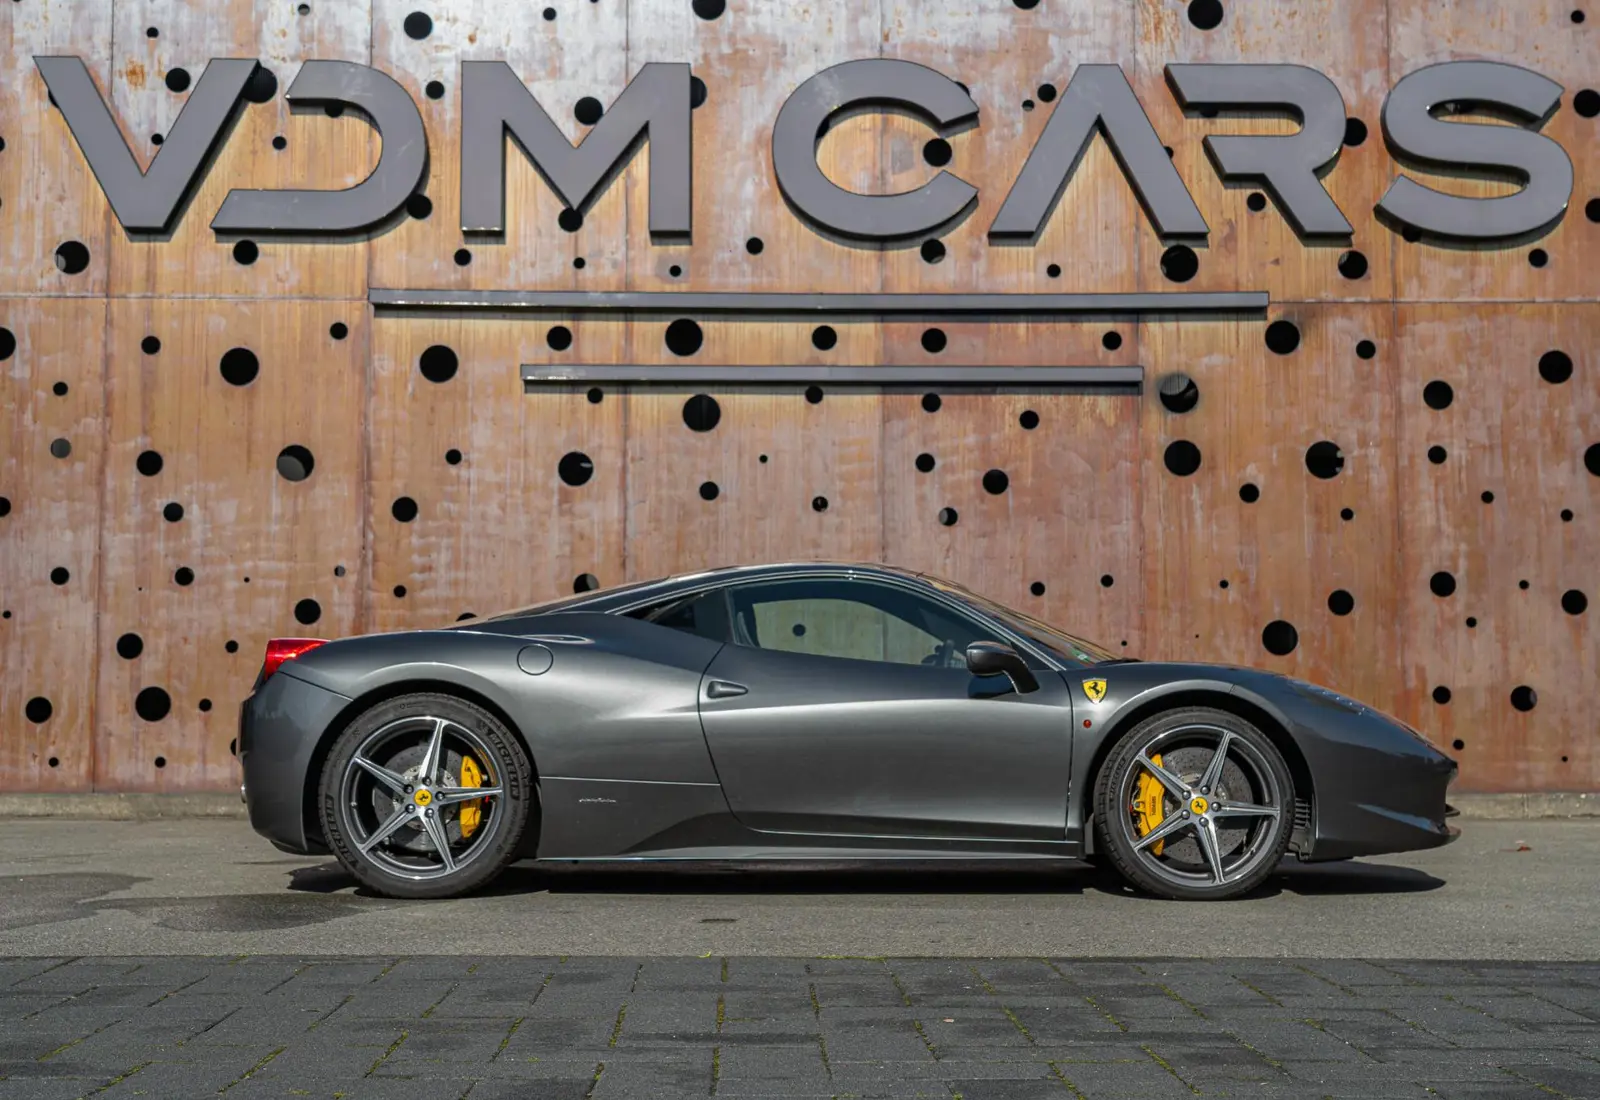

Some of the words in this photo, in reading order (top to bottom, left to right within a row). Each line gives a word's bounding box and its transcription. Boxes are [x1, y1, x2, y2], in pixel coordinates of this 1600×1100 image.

[33, 56, 693, 239] VDM
[773, 58, 1574, 240] CARS
[489, 732, 520, 797] MICHELIN
